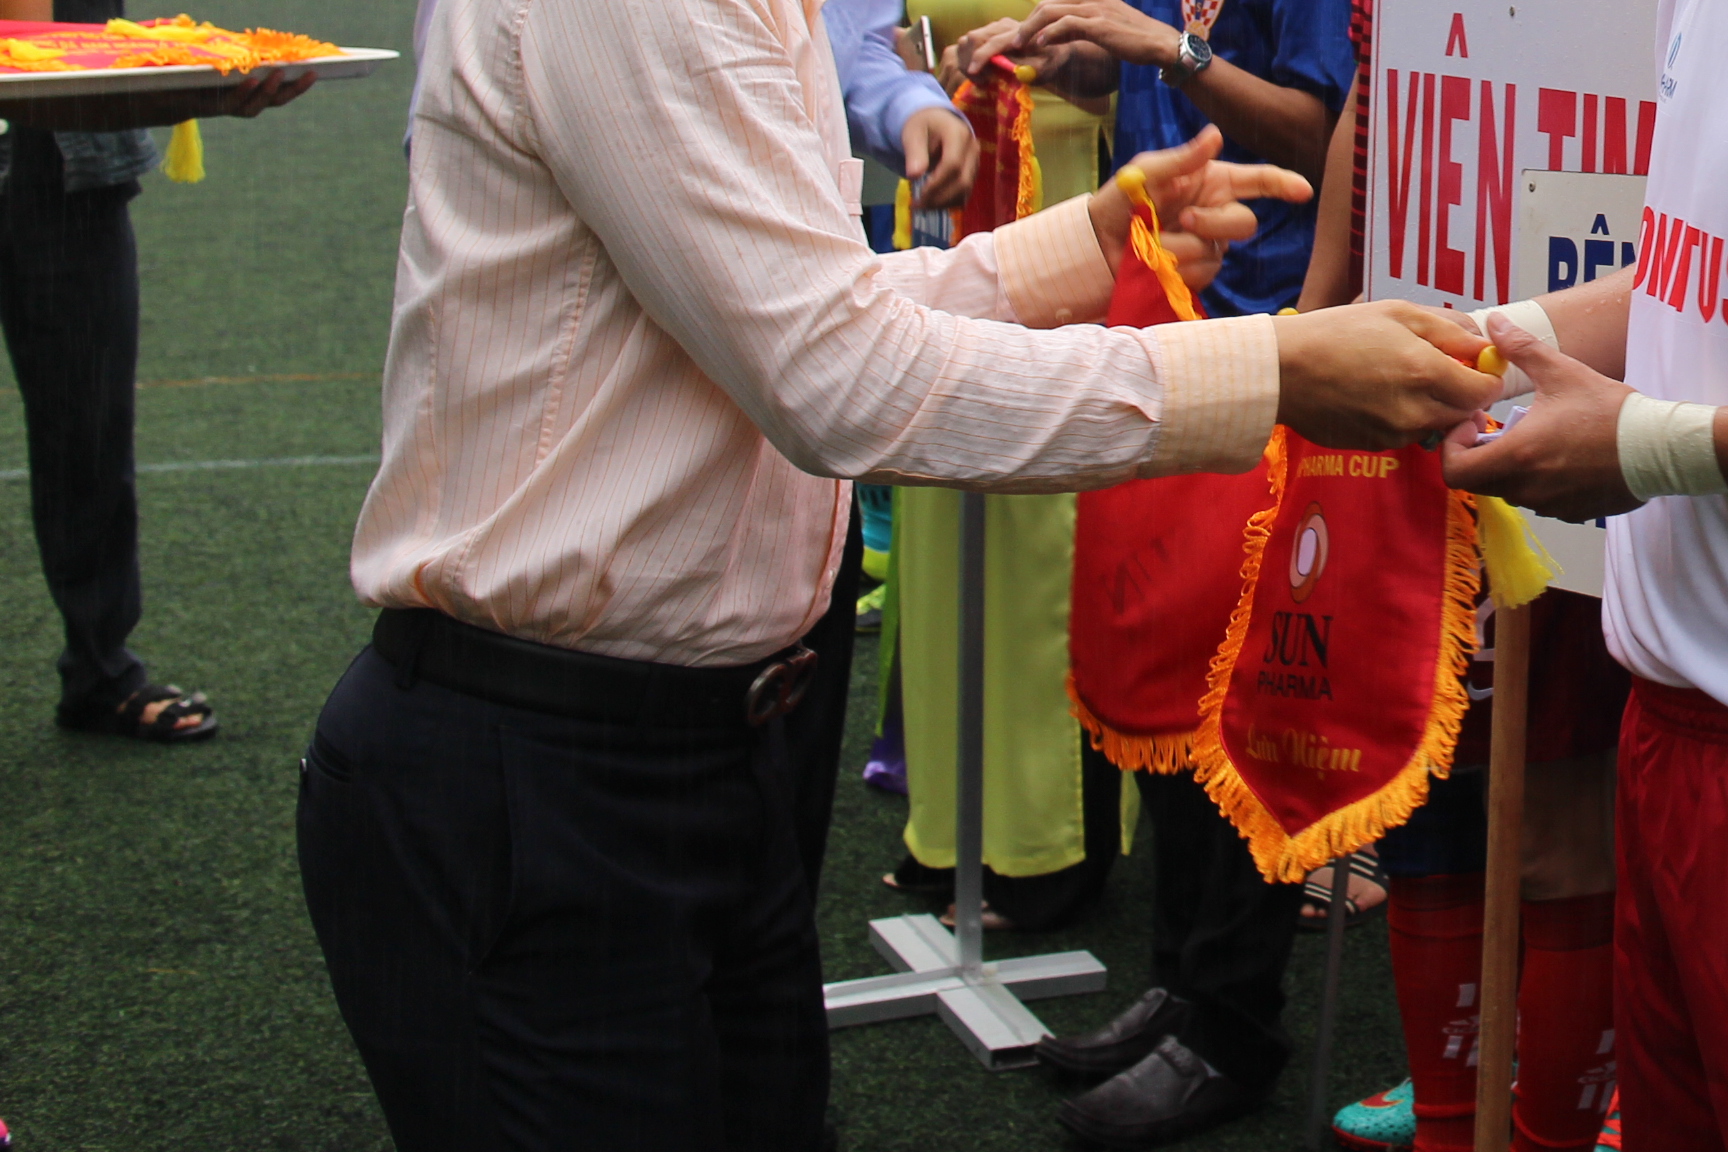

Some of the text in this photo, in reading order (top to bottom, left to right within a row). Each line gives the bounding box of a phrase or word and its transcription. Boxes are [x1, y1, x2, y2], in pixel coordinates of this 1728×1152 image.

[1349, 454, 1400, 479] CUP
[1264, 611, 1334, 669] SUN
[1257, 671, 1334, 701] PHARMA
